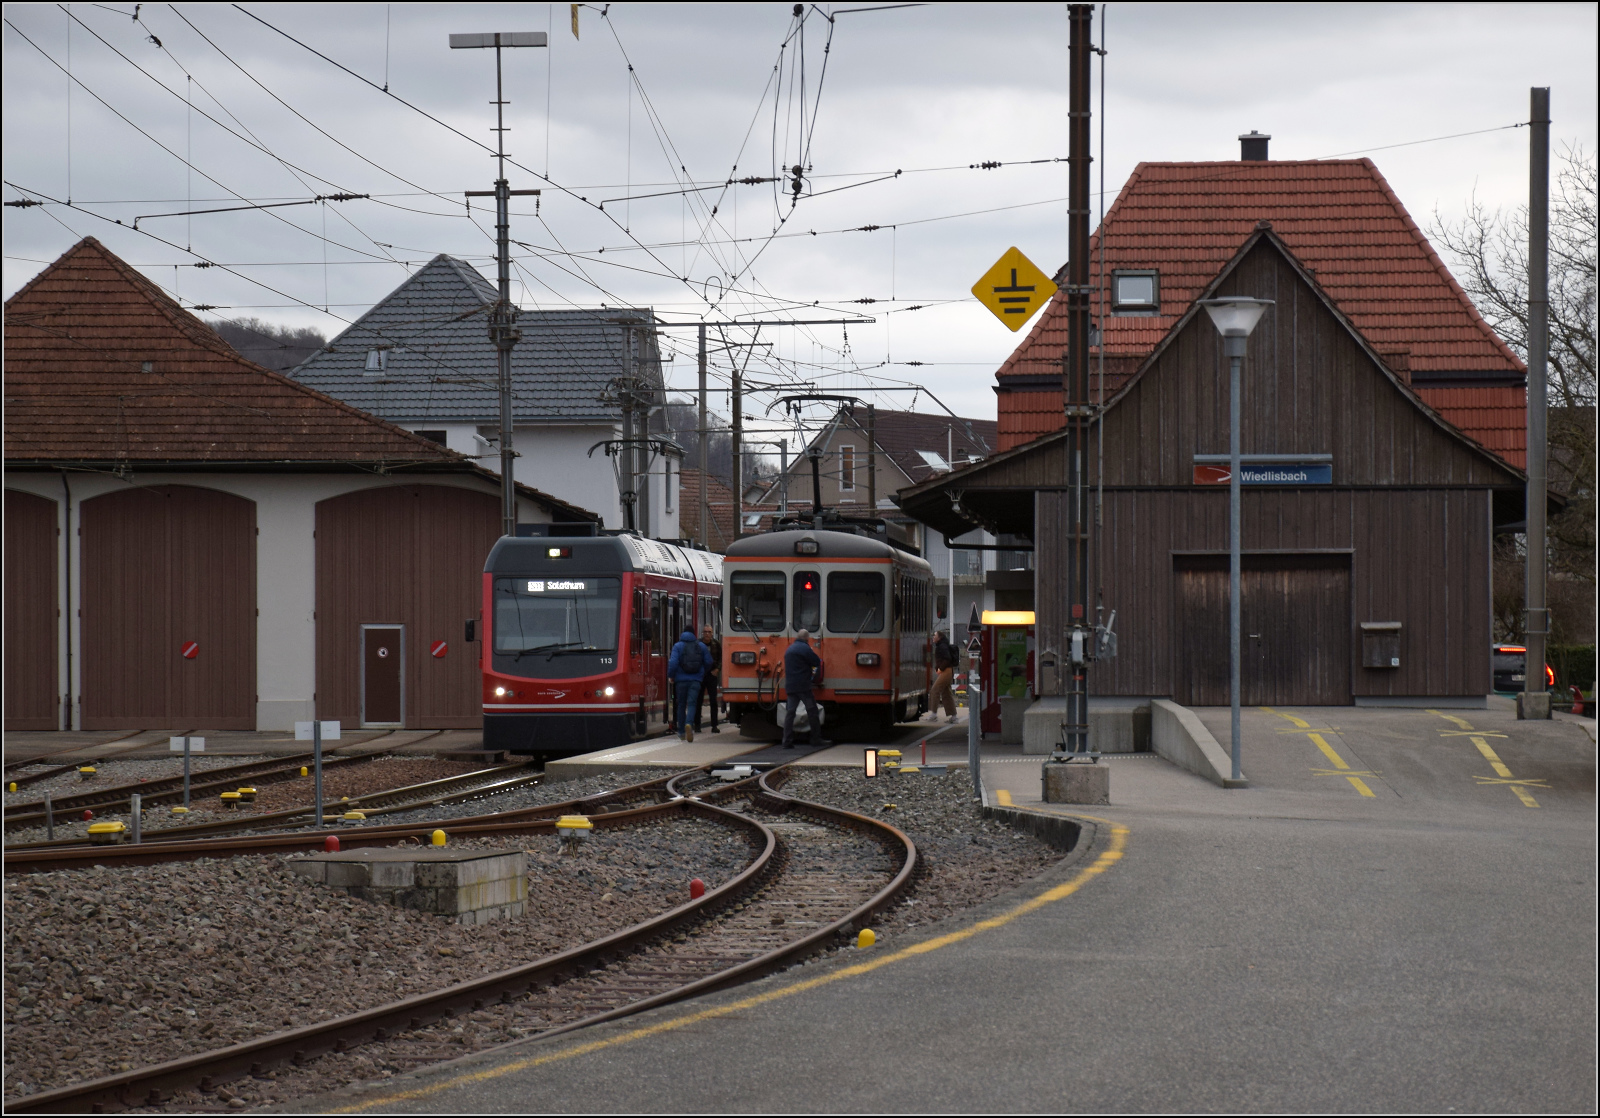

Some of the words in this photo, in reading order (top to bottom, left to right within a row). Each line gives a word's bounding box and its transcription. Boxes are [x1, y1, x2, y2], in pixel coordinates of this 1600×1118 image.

[1241, 471, 1307, 482] Wiedlisbach
[547, 581, 585, 590] Solothurn
[600, 657, 613, 665] 113
